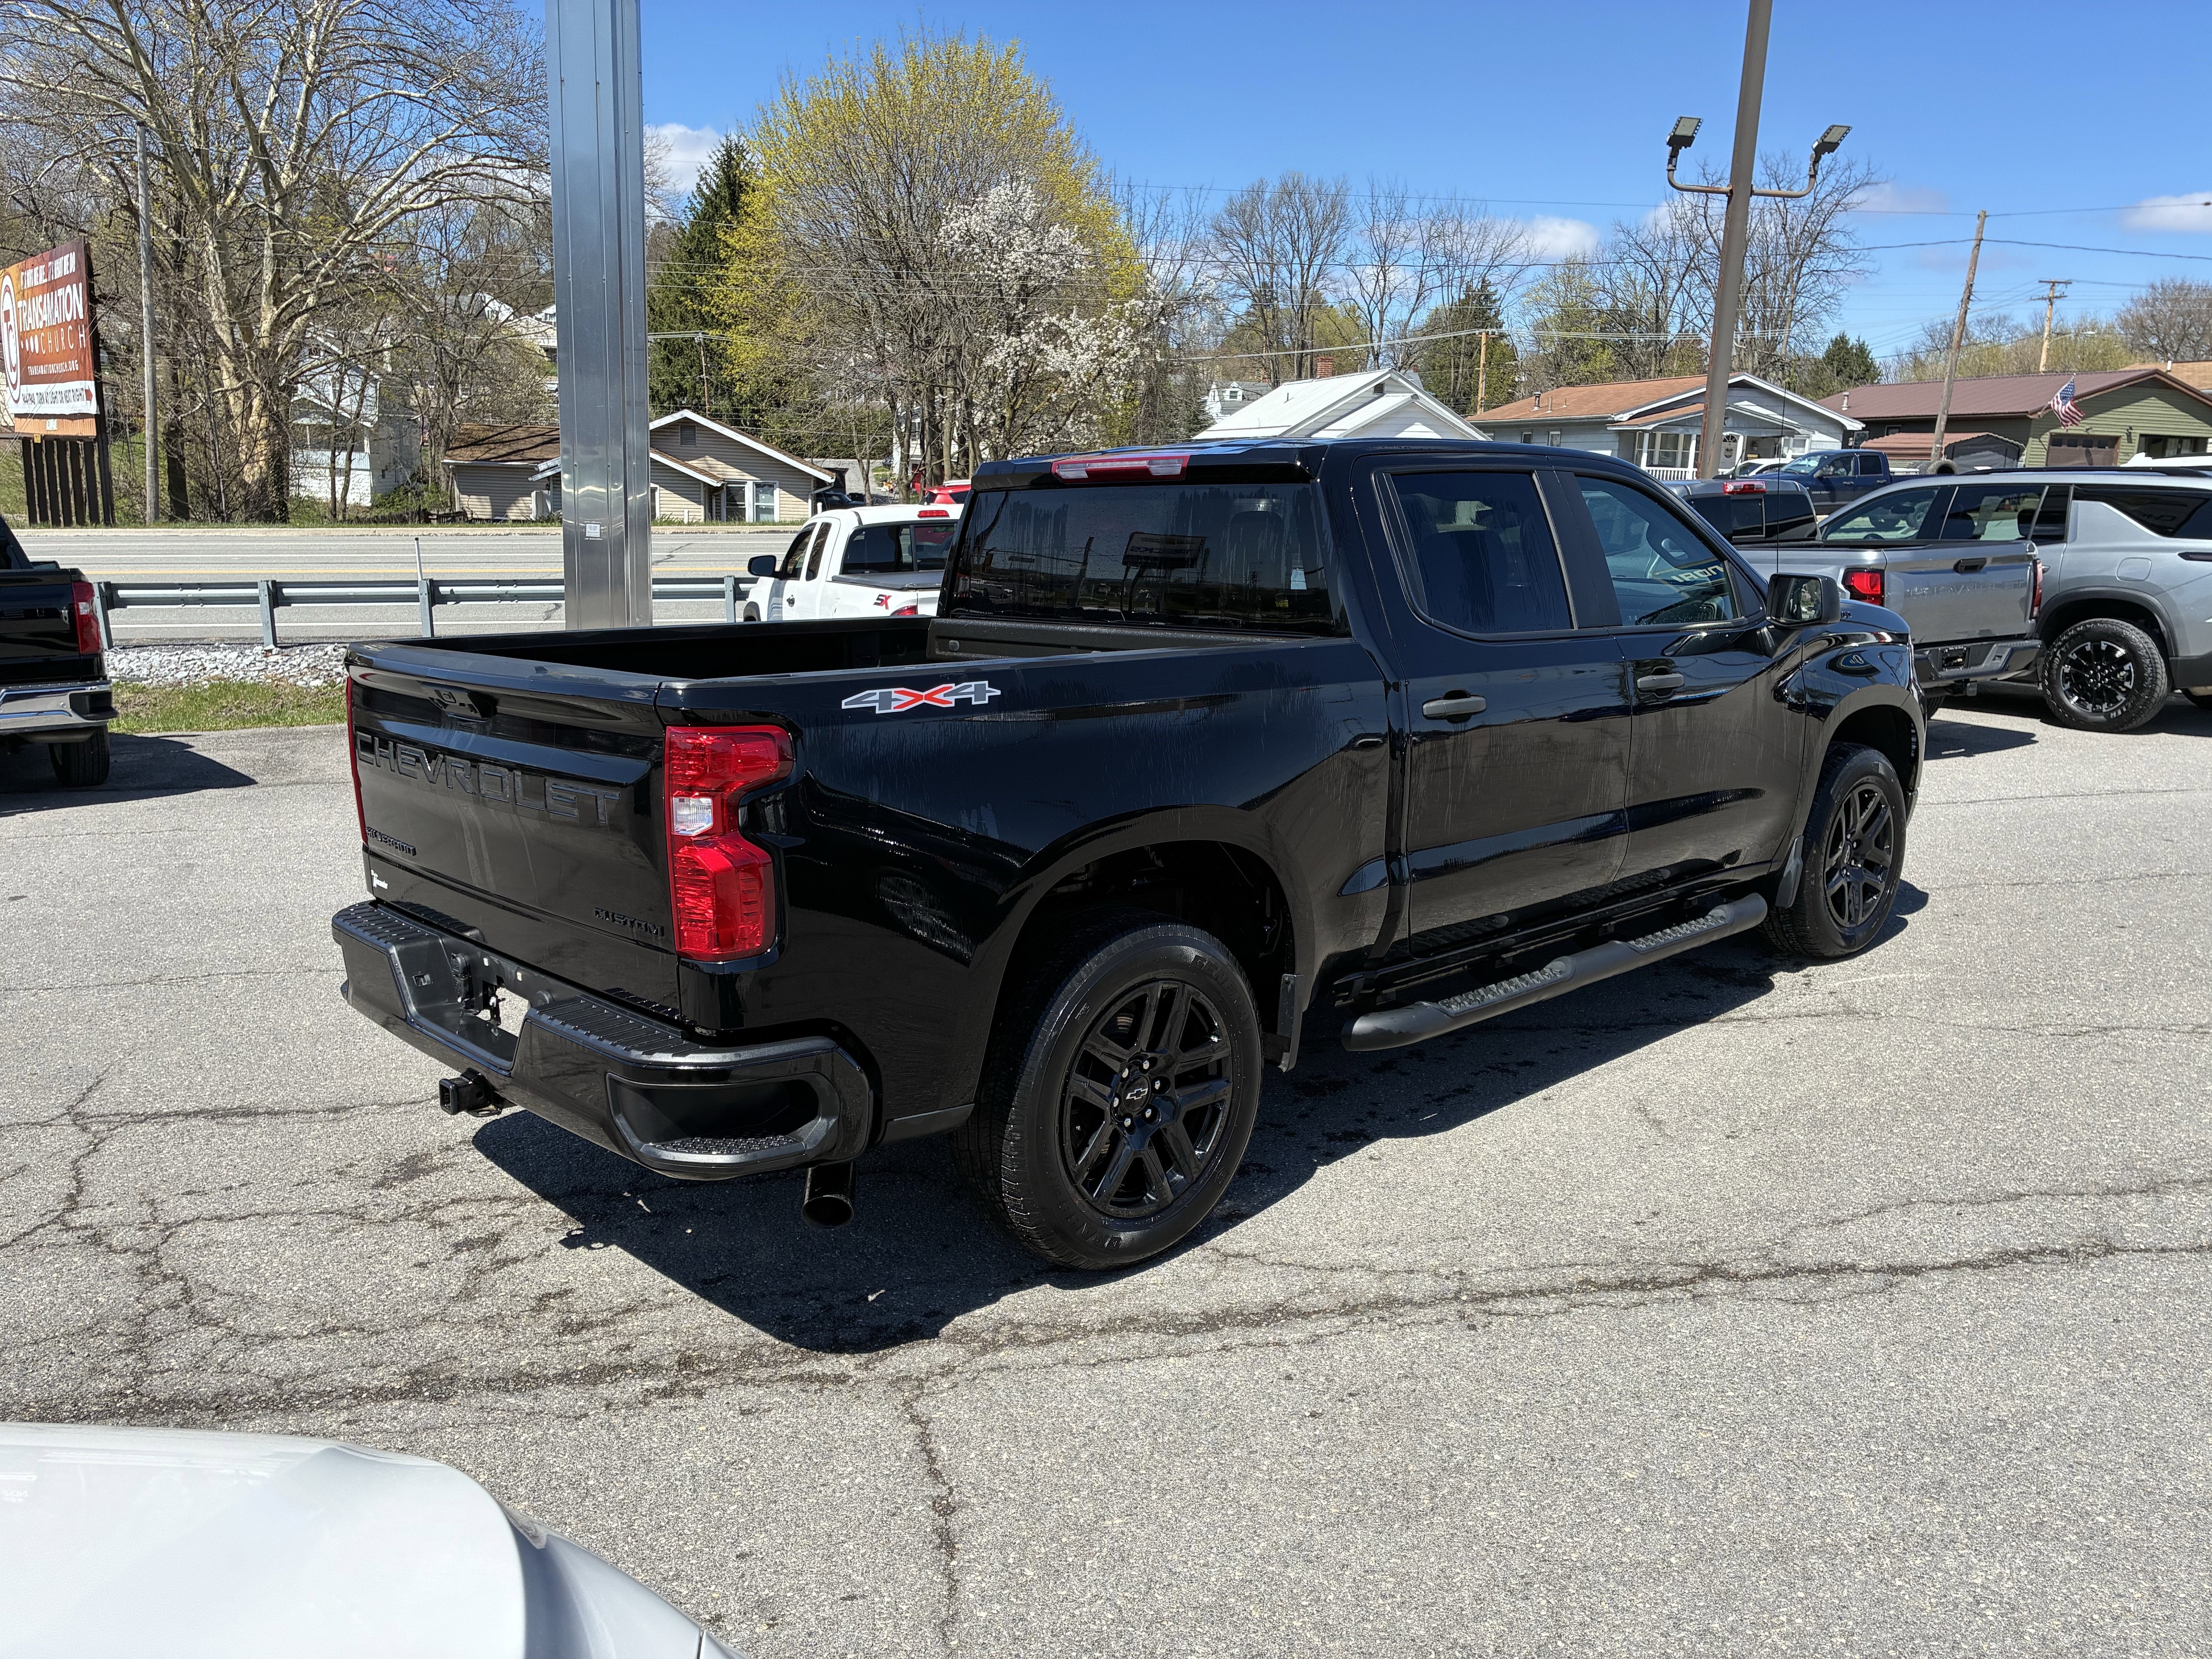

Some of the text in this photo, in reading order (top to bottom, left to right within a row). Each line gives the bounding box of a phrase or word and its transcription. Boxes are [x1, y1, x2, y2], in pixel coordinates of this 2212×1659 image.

[17, 282, 83, 332] TRANS4MATION
[40, 324, 86, 355] CHURCH
[356, 732, 620, 825] CHEVROLET
[366, 826, 417, 856] SILVERADO
[594, 907, 665, 937] CUSTOM
